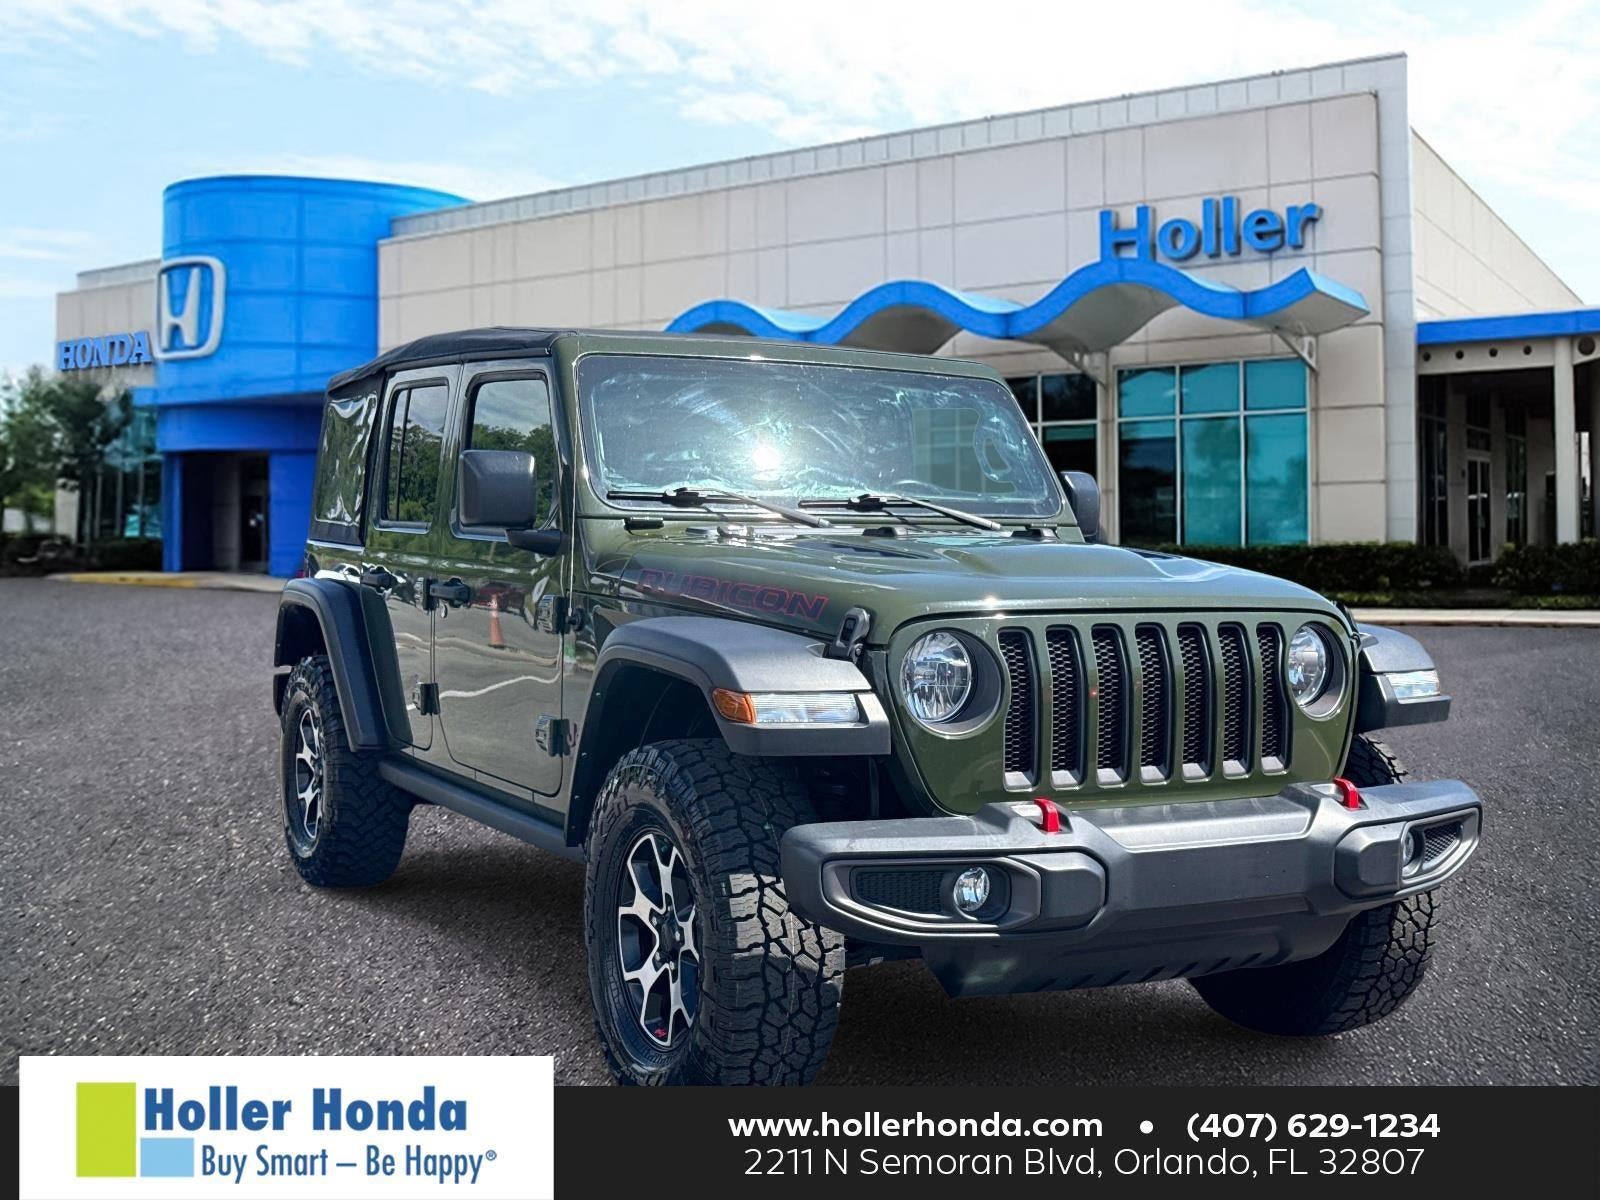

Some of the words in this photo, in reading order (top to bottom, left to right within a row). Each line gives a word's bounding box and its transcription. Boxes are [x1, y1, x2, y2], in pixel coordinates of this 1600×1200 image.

[1099, 195, 1320, 262] Holler
[57, 331, 152, 371] HONDA
[636, 568, 829, 621] RUBICON
